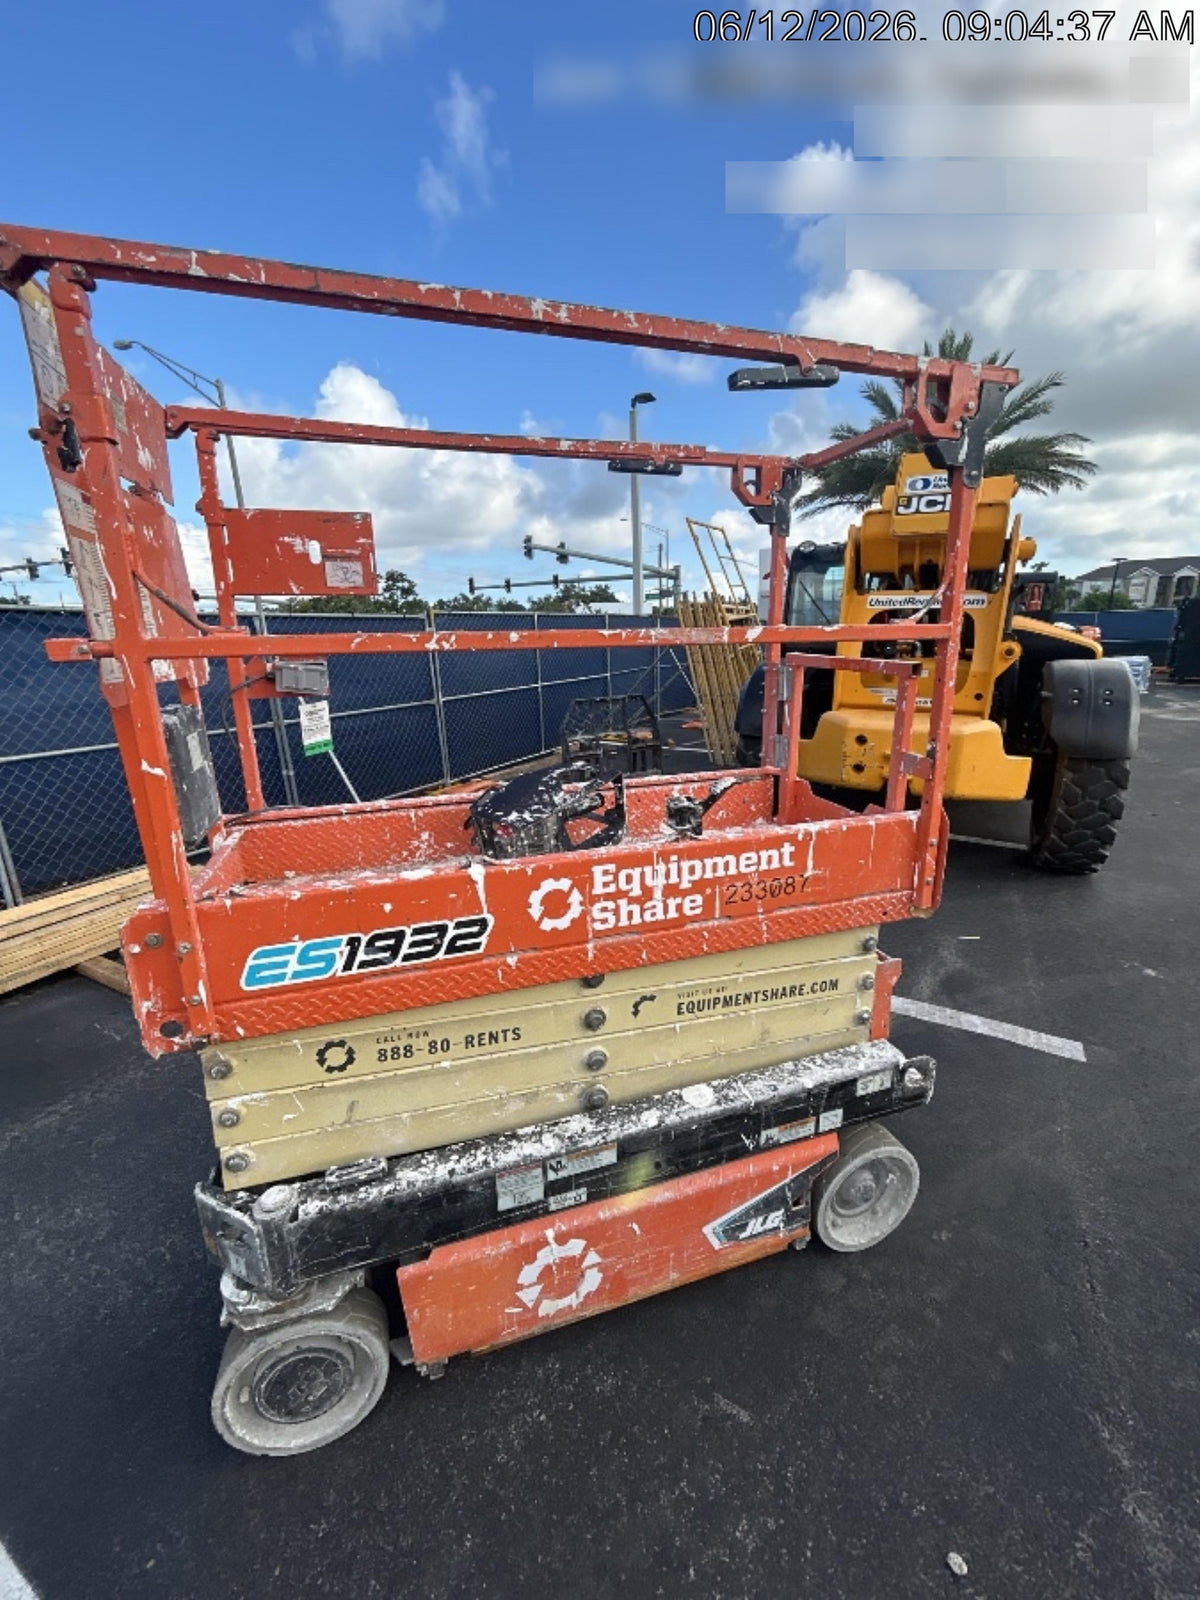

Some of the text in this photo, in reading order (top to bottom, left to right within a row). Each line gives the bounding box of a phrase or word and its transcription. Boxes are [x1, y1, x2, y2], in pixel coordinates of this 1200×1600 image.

[592, 844, 796, 894] Equipment
[725, 873, 811, 905] 233087
[592, 892, 703, 930] Share
[243, 916, 492, 989] ES1932
[676, 979, 839, 1016] EQUIPMENTSHARE.COM
[376, 1035, 402, 1045] CALL
[377, 1027, 522, 1063] 888-80-RENTS
